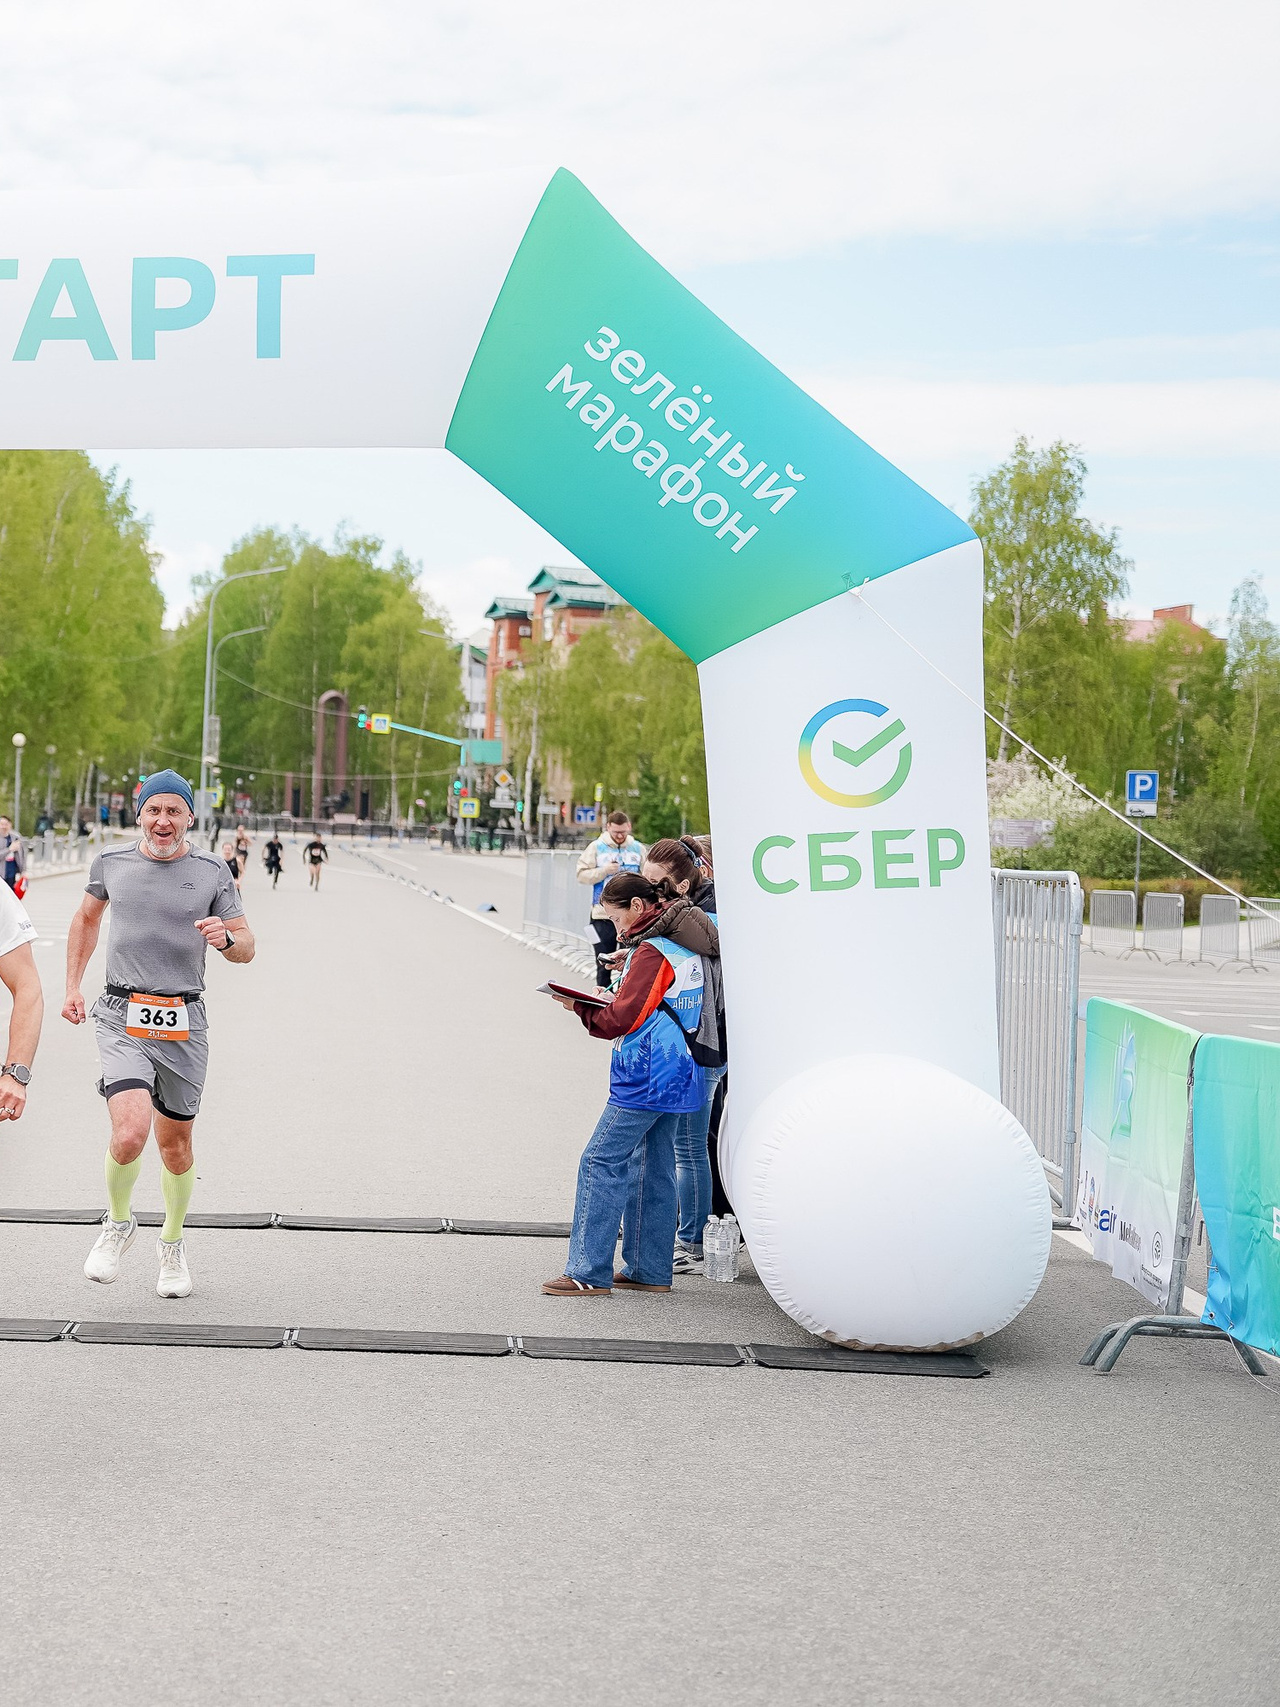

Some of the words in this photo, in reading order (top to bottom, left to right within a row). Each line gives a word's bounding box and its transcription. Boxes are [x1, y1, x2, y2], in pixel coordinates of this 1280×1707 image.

[583, 325, 806, 515] зелёный
[545, 362, 760, 554] марафон
[1134, 774, 1153, 799] P
[752, 828, 966, 894] СБЕР
[139, 1008, 178, 1027] 363
